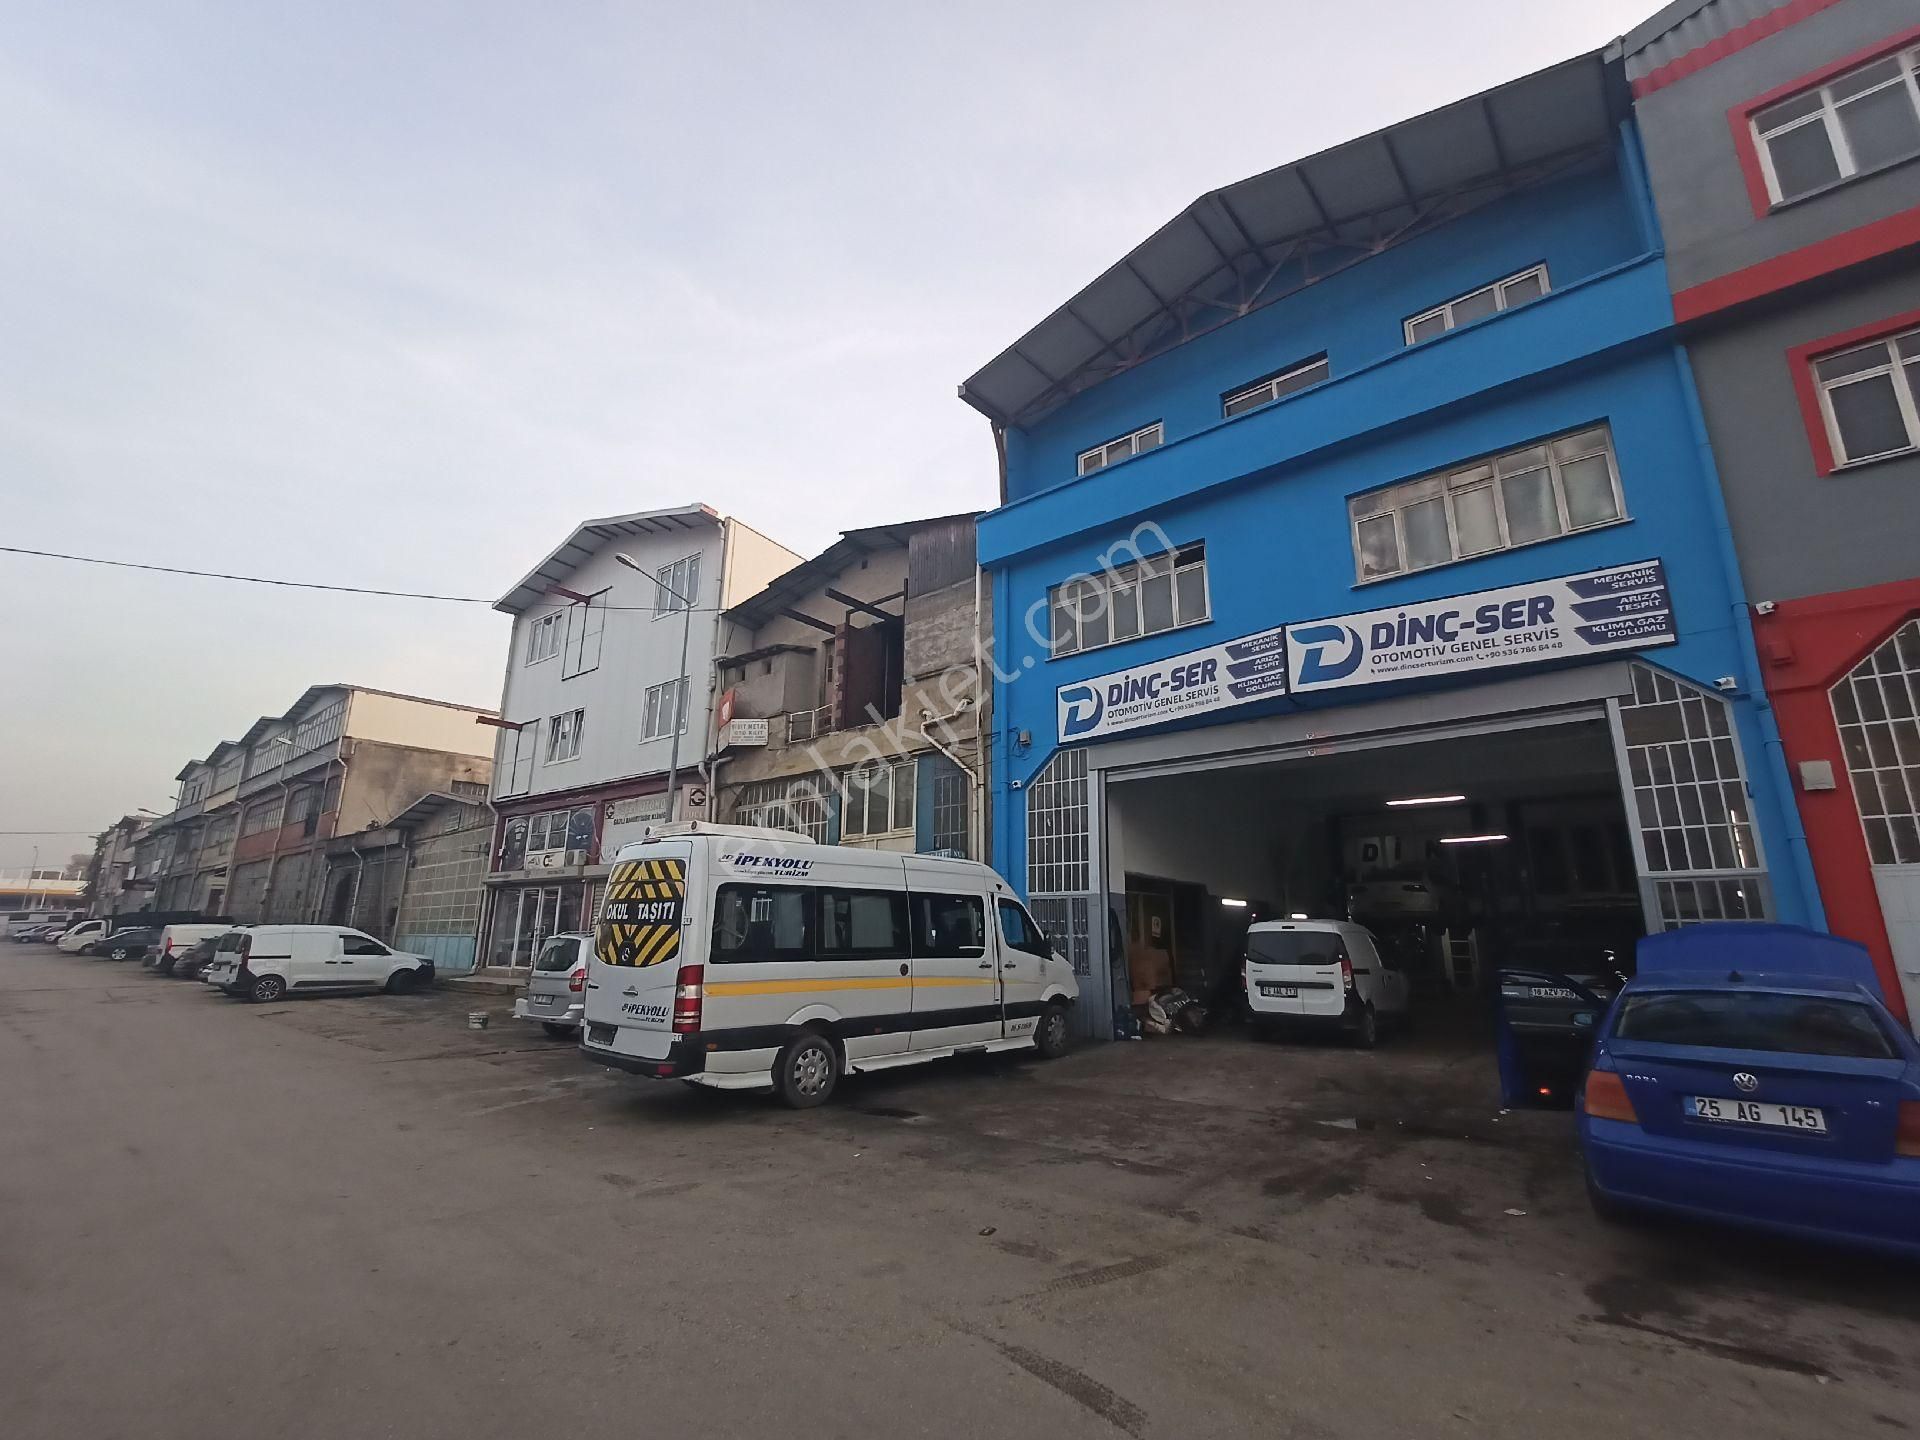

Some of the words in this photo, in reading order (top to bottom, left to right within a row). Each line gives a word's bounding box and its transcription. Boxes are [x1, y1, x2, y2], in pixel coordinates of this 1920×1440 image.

[1593, 567, 1656, 585] MEKANİK
[1611, 575, 1657, 589] SERVİS
[1616, 599, 1662, 612] TESPİT
[1619, 592, 1660, 604] ARIZA
[1370, 595, 1555, 650] DİNÇ-SER
[1637, 615, 1665, 626] GAZ
[1607, 623, 1666, 638] DOLUMU
[1241, 634, 1279, 649] MEKANİK
[1251, 640, 1279, 653] SERVİS
[1371, 643, 1448, 665] OTOMOTİV
[1450, 638, 1501, 653] GENEL
[1504, 627, 1560, 646] SERVİS
[1254, 654, 1280, 665] ARIZA
[1107, 658, 1218, 707] DİNÇ-SER
[1263, 673, 1281, 682] GAZ
[1245, 680, 1282, 693] DOLUMU
[1107, 701, 1153, 719] OTOMOTİV
[1154, 693, 1185, 709] GENEL
[1185, 684, 1219, 702] SERVİS
[734, 853, 815, 870] İPEKYOLU
[606, 903, 629, 920] OKUL
[637, 901, 676, 923] TAŞITI
[1696, 1098, 1721, 1117] 25
[1737, 1102, 1761, 1121] AG
[1778, 1106, 1818, 1128] 145
